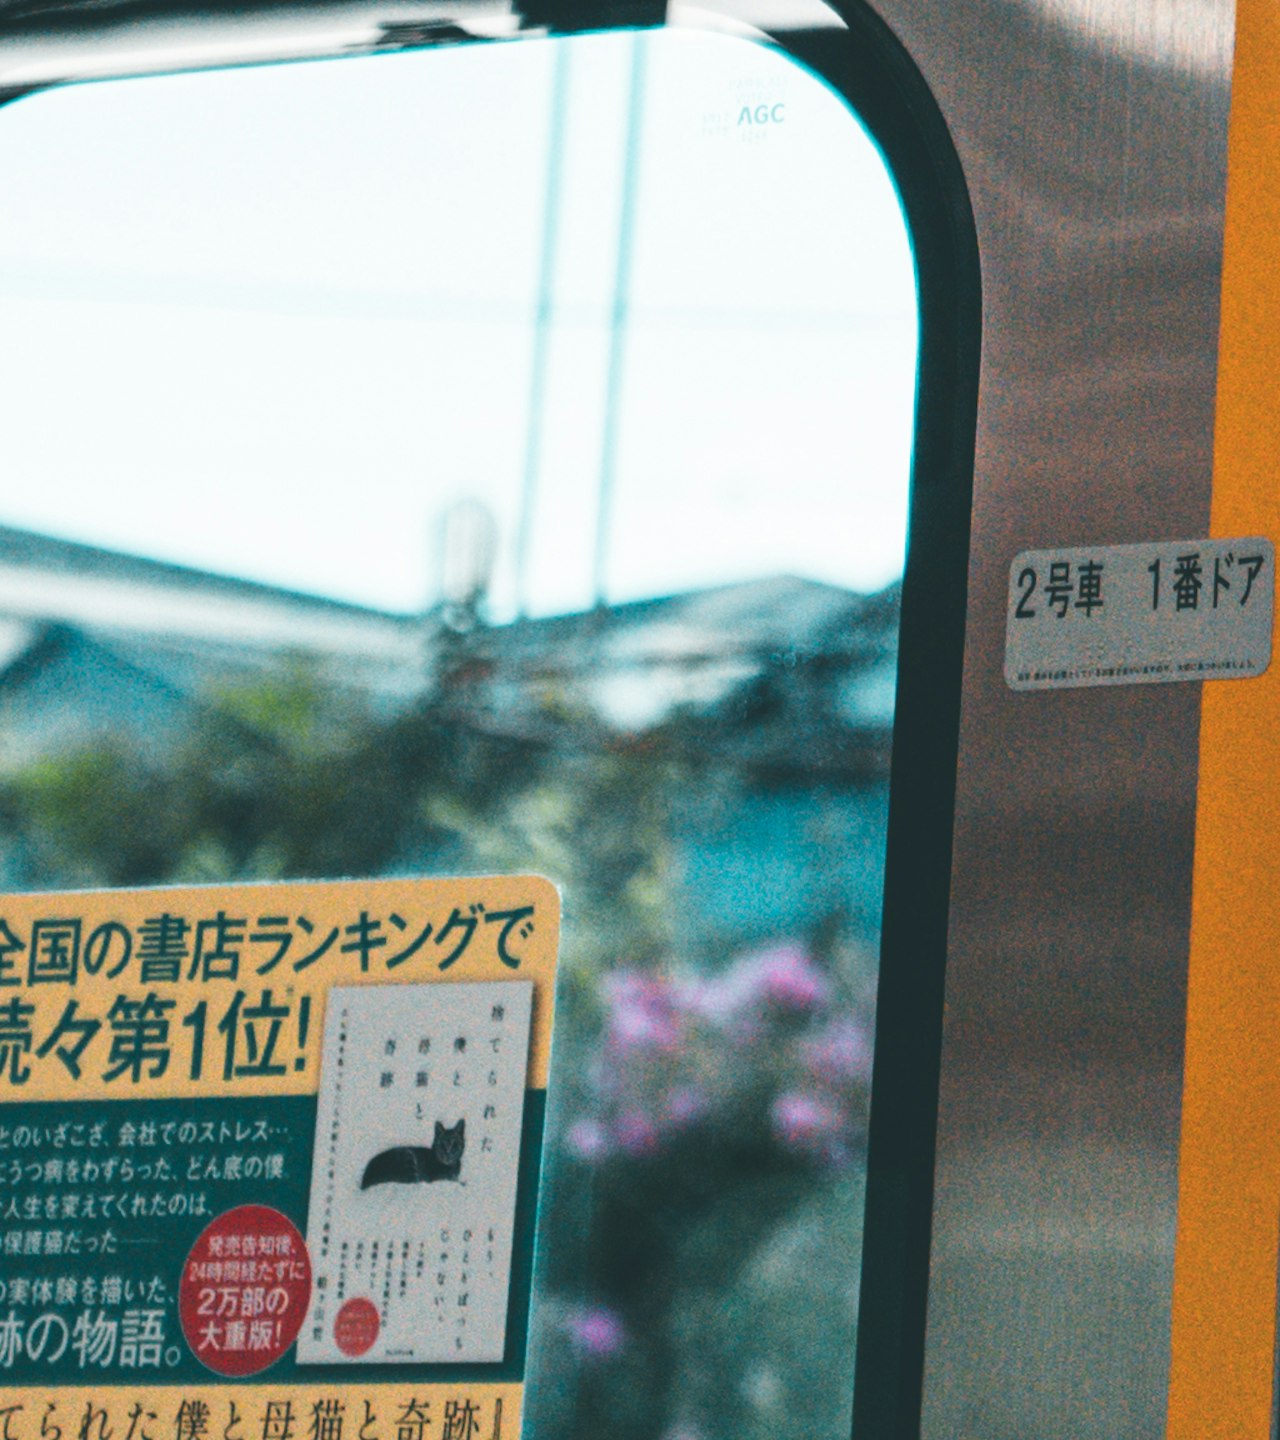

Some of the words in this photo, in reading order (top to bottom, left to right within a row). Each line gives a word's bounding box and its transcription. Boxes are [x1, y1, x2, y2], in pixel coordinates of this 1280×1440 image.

[737, 103, 785, 126] AGC
[1014, 559, 1104, 619] 2号車
[1147, 551, 1265, 612] 1番ドア
[197, 1287, 289, 1317] 2万部の
